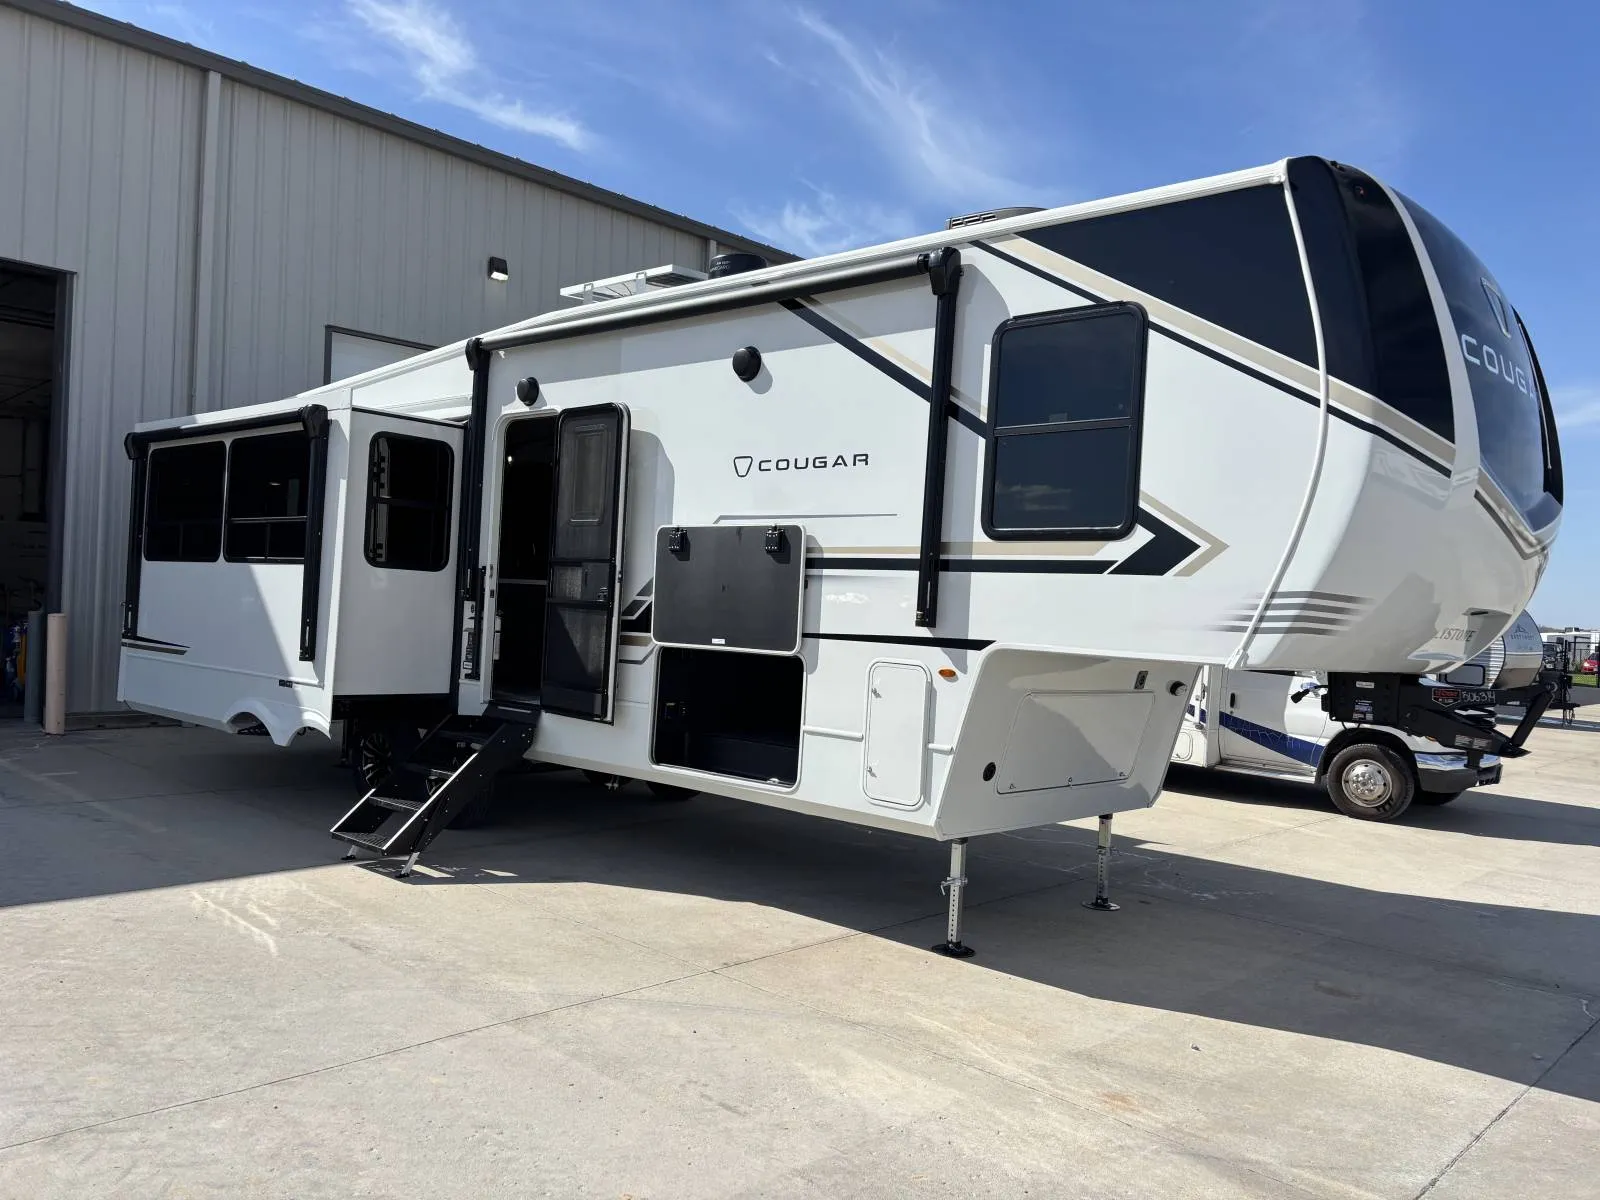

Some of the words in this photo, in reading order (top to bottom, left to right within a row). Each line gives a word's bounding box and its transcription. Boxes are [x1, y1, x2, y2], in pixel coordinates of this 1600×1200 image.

[1460, 333, 1537, 401] COUGA
[758, 453, 869, 472] COUGAR
[1432, 627, 1477, 642] YSTONE
